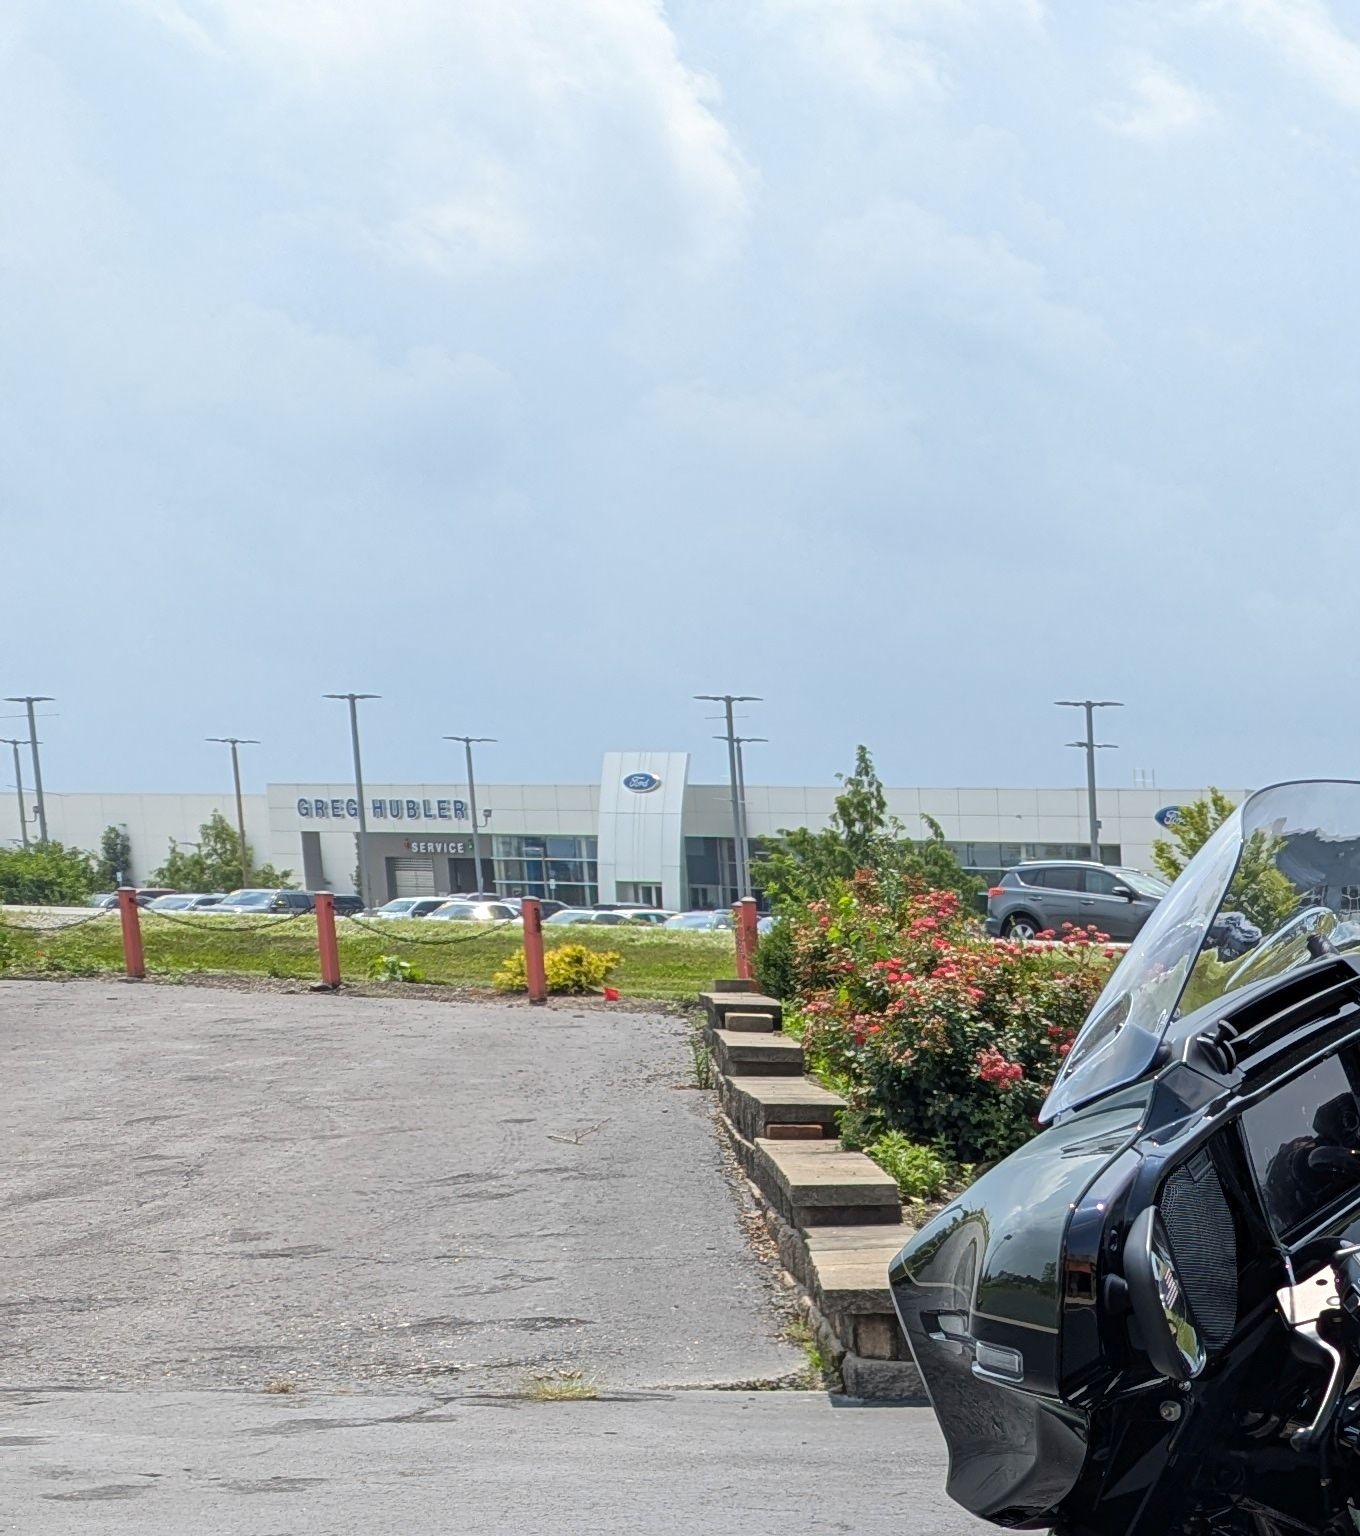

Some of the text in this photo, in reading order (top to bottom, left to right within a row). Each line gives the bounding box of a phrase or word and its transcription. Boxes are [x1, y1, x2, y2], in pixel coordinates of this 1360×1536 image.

[297, 798, 467, 819] GREG HUBLER
[411, 842, 464, 853] SERVICE
